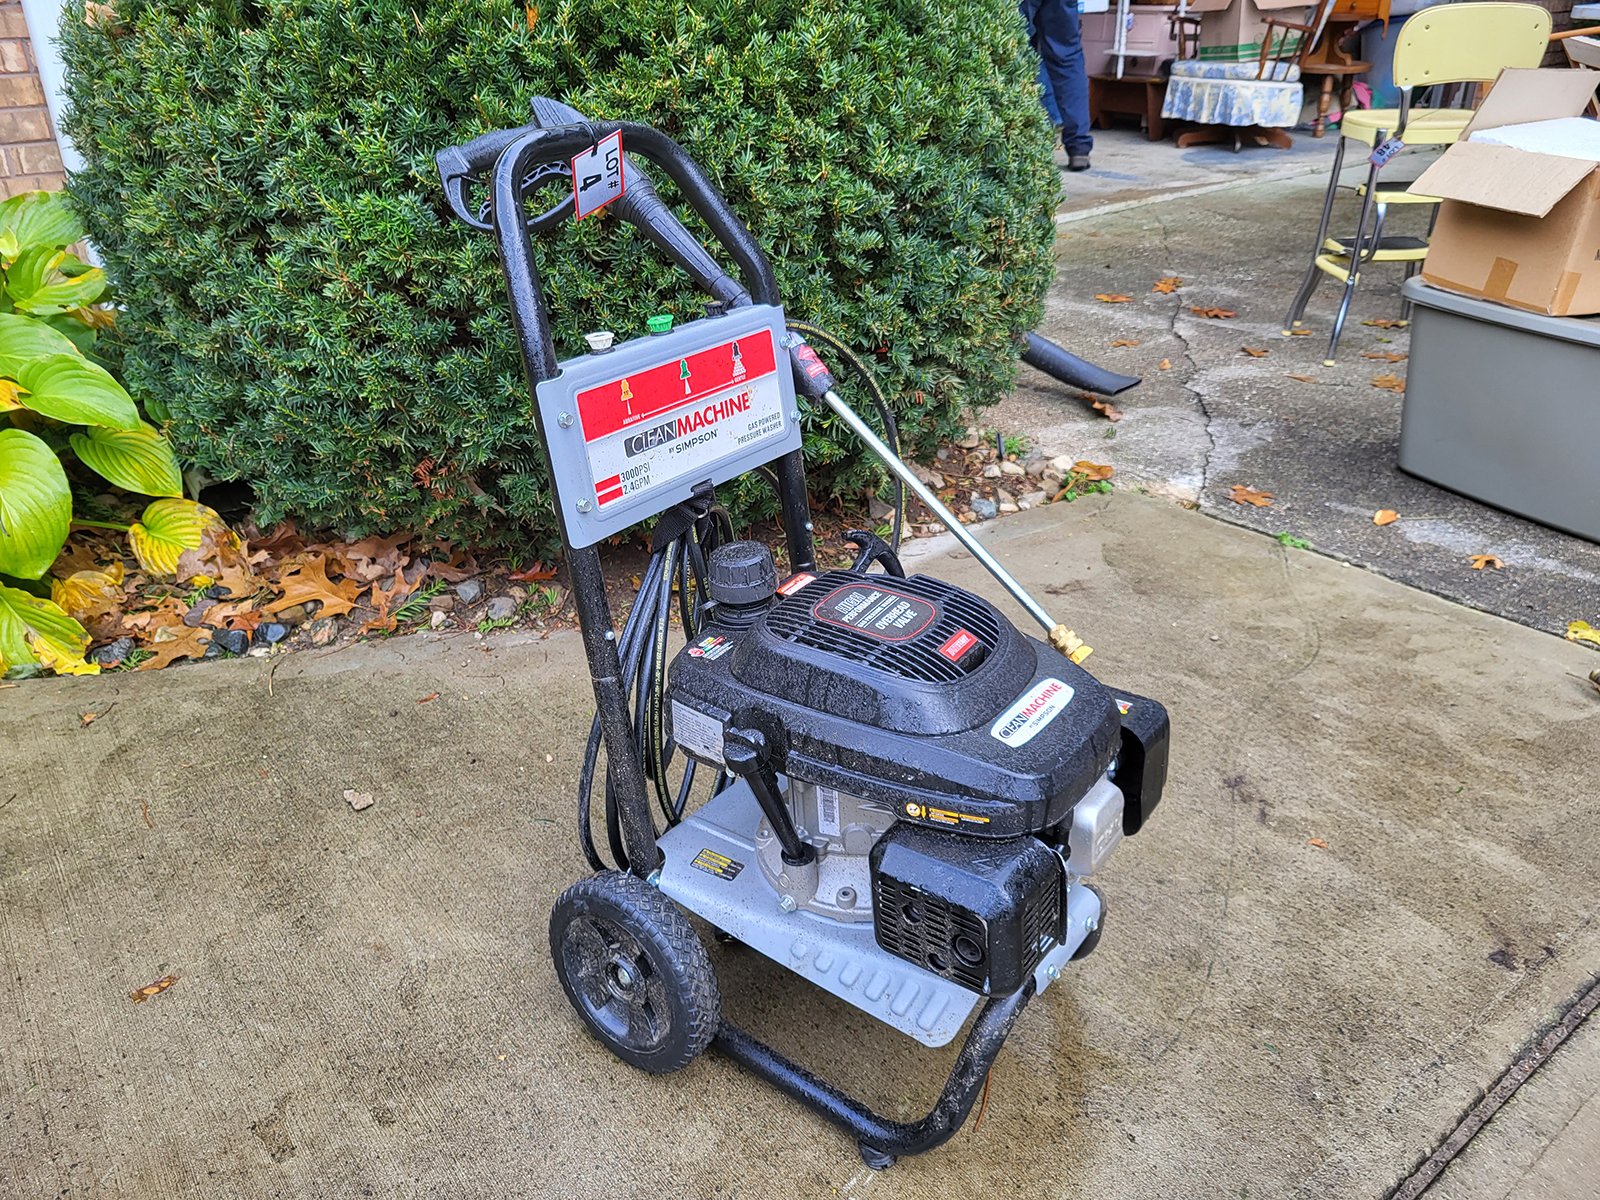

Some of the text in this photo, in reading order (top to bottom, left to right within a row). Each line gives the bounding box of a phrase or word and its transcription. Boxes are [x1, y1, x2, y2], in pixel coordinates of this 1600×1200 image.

[605, 147, 619, 189] LOT #
[580, 173, 602, 193] 4
[737, 420, 782, 445] PRESSURE WASHER
[747, 411, 781, 431] GAS POWERED
[675, 429, 717, 454] SIMPSON
[620, 461, 651, 483] 3000PSI
[623, 475, 651, 495] 2.4GPM
[841, 590, 883, 623] PERFORMANCE
[875, 601, 911, 630] OVERHEAD
[892, 609, 918, 629] VALVE
